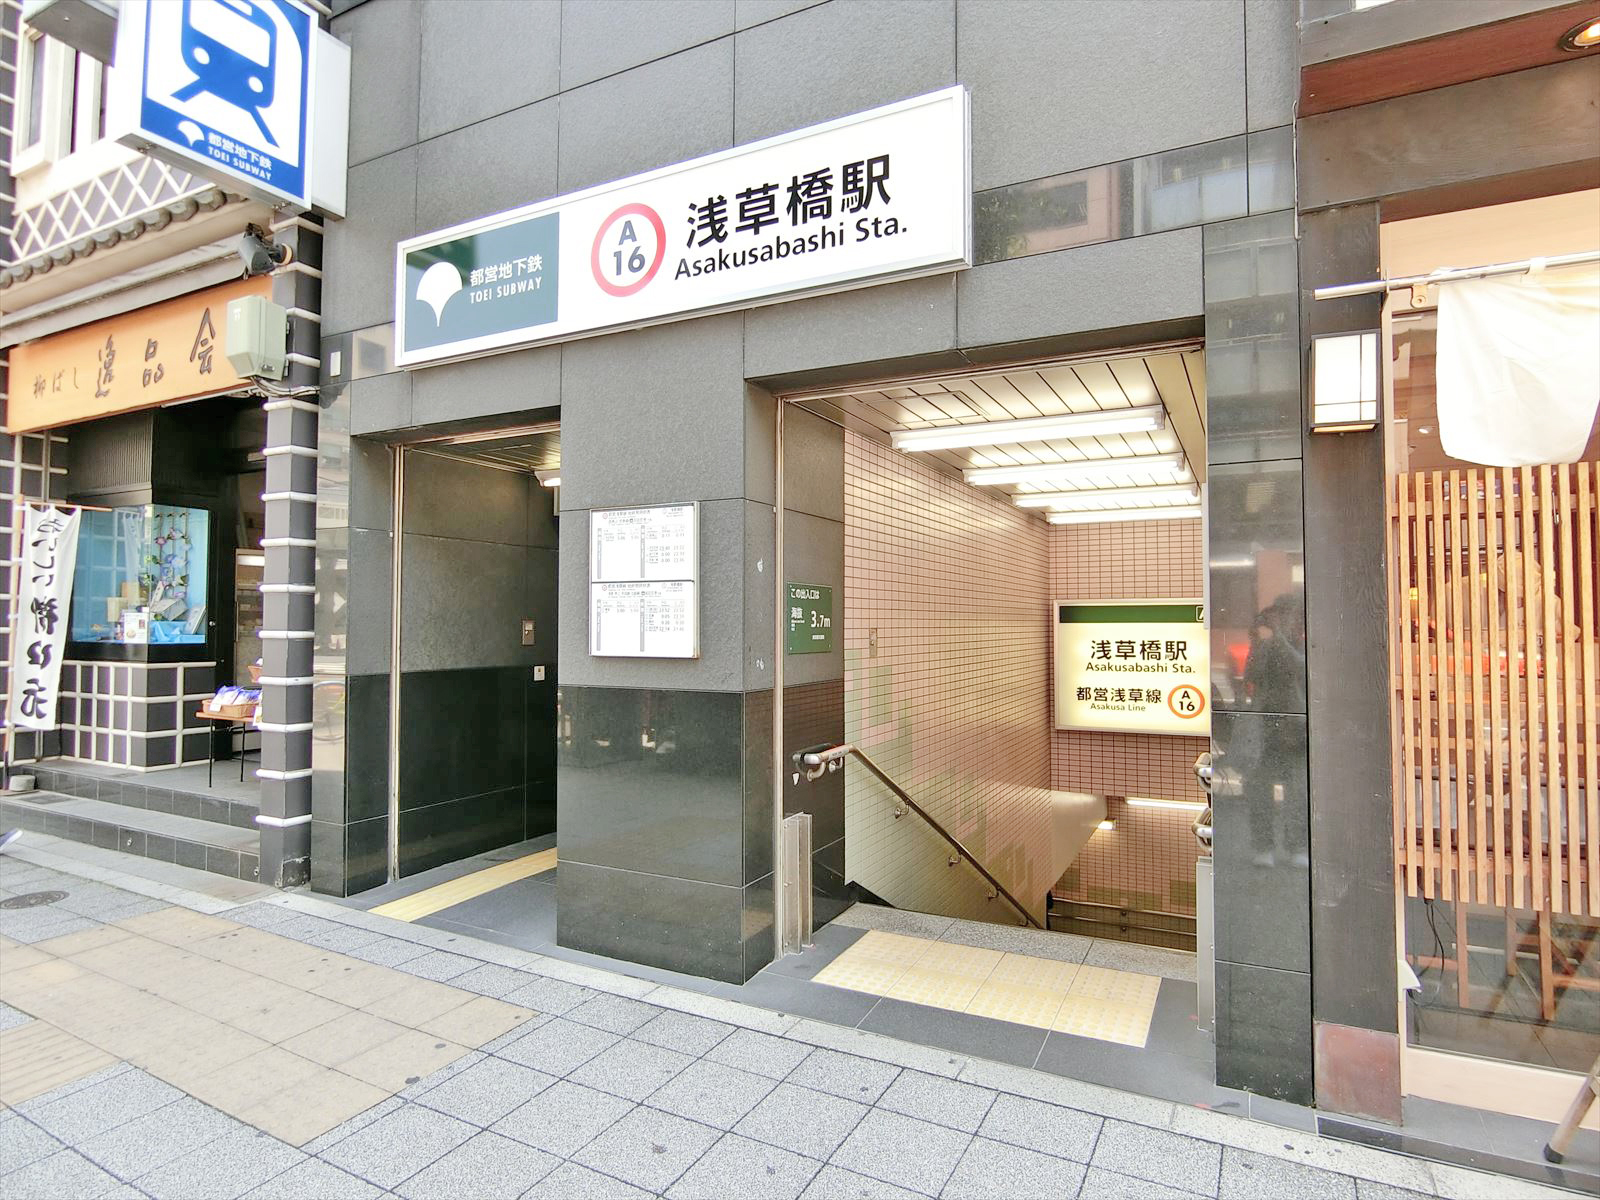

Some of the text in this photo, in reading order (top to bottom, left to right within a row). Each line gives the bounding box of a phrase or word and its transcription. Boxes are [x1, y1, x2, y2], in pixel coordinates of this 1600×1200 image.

[208, 132, 272, 170] 都営地下鉄
[208, 146, 272, 180] TOEI SUBWAY
[686, 154, 891, 249] 浅草橋駅
[618, 220, 638, 245] A
[613, 246, 646, 276] 16
[674, 217, 907, 280] Asakusabashi Sta.
[470, 253, 543, 287] 都営地下鉄
[470, 276, 542, 304] TOEI SUBWAY
[1091, 640, 1188, 661] 浅草橋駅
[1086, 662, 1196, 673] Asakusabashi Sta.
[1076, 687, 1162, 703] 都営浅草線
[1090, 703, 1146, 712] Asakusa Line
[1178, 701, 1195, 712] 16
[1181, 690, 1191, 700] A
